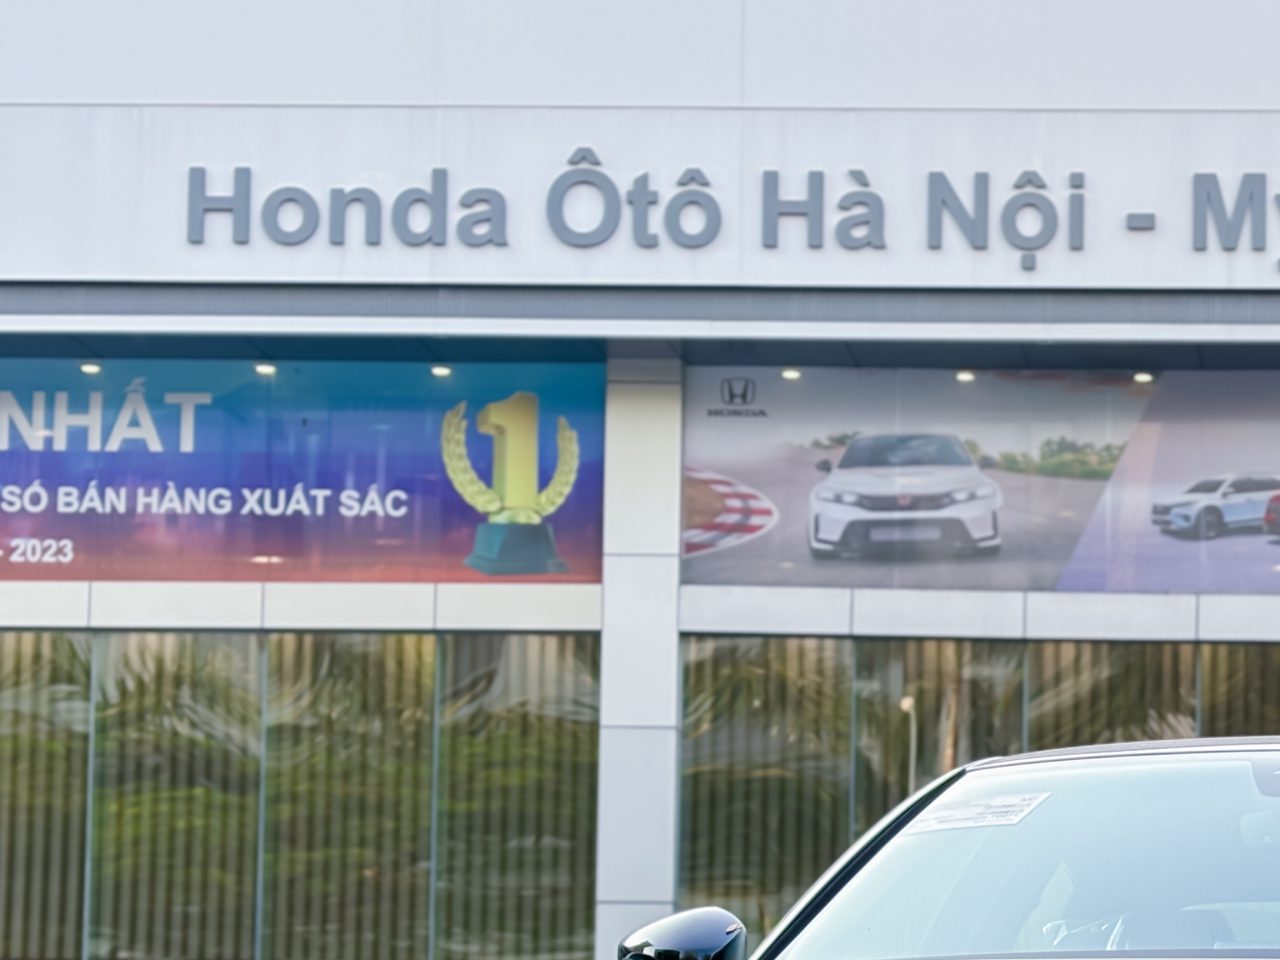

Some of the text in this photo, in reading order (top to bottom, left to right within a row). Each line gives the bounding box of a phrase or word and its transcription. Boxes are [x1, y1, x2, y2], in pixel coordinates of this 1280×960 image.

[187, 166, 508, 247] Honda
[546, 147, 722, 250] Ôtô
[762, 169, 886, 250] Hà
[926, 170, 1085, 271] Nội
[1126, 212, 1156, 231] -
[0, 377, 213, 453] NHẤT
[56, 480, 127, 514] BÁN
[136, 481, 233, 515] HÀNG
[9, 538, 74, 563] 2023
